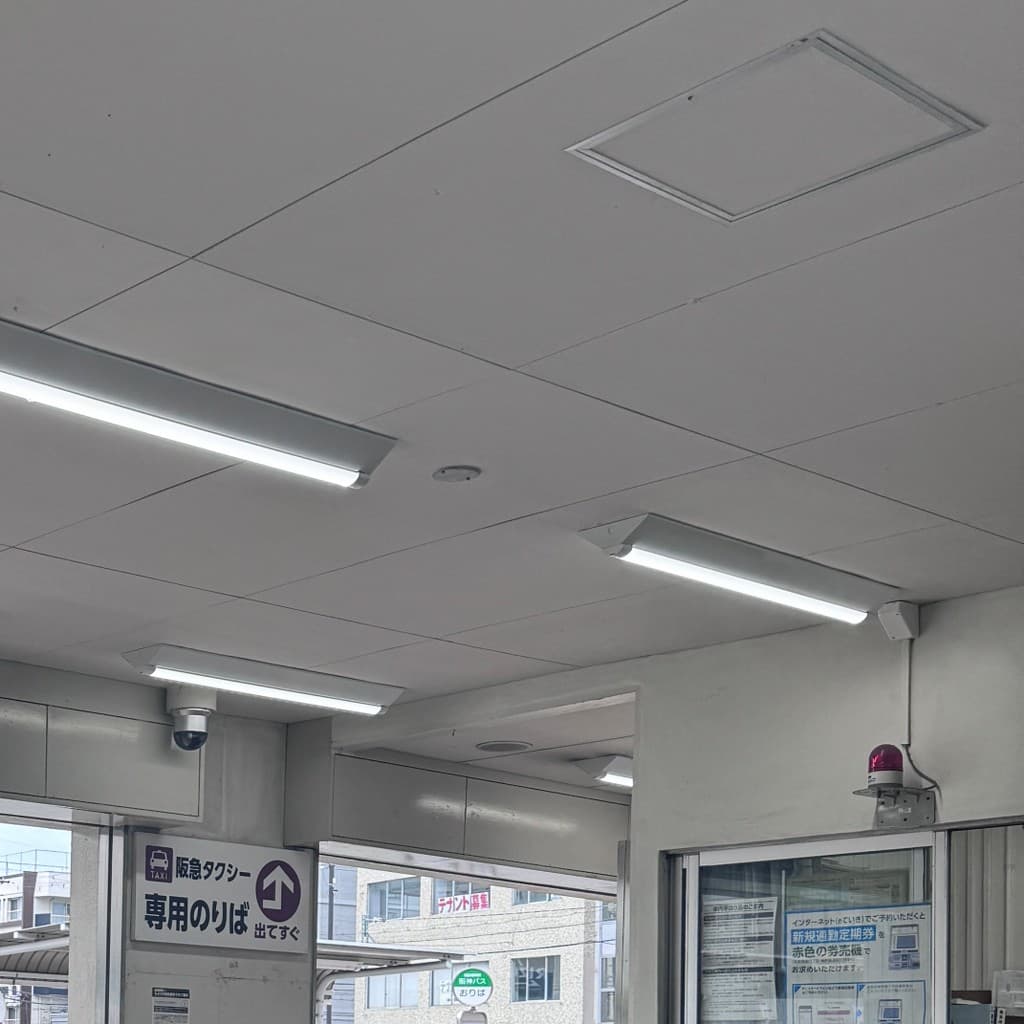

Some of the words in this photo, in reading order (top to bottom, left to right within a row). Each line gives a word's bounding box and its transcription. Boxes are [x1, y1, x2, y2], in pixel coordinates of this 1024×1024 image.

[150, 870, 169, 880] TAXI
[175, 856, 252, 882] 阪急タクシー
[144, 893, 251, 935] 専用のりば
[254, 922, 302, 941] 出てすぐ
